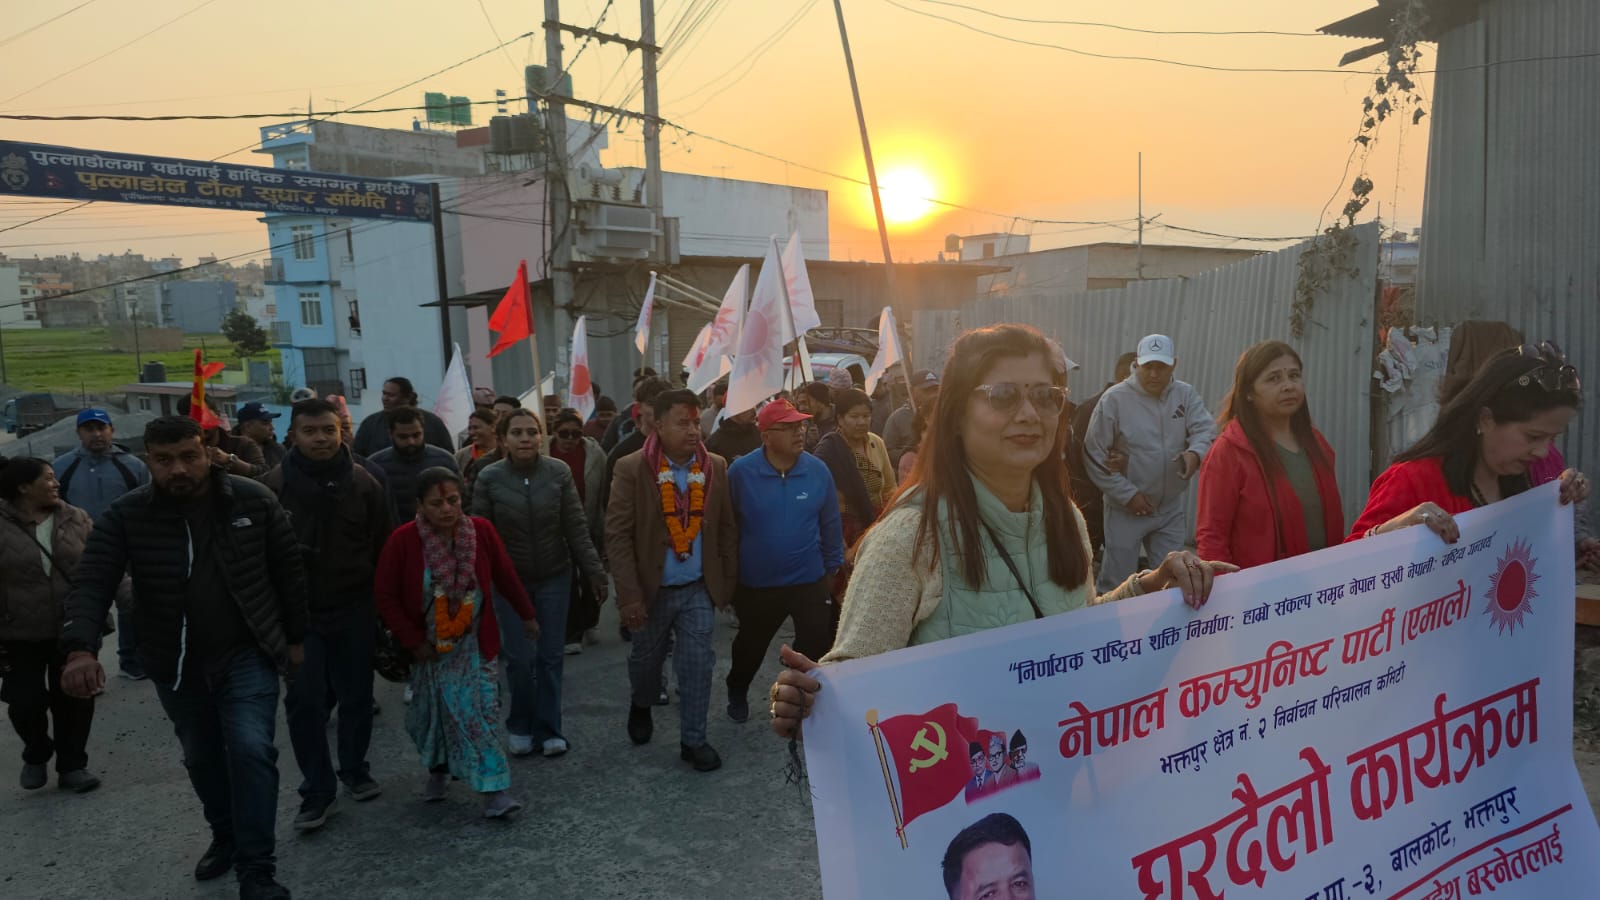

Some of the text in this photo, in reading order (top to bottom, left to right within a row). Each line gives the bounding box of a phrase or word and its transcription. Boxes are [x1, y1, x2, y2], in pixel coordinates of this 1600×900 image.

[252, 186, 316, 204] सुधार
[325, 190, 387, 209] समिति
[291, 175, 360, 190] स्वागत
[1091, 638, 1143, 663] राष्ट्रिय
[1149, 627, 1182, 651] शक्ति
[1242, 602, 1271, 625] हाम्रो
[1274, 593, 1312, 617] संकल्प
[1349, 578, 1376, 595] नेपाल
[1381, 565, 1404, 589] सुखी
[1058, 579, 1471, 758] नेपाल कम्युनिष्ट पार्टी (एमाले)
[1160, 740, 1207, 774] भक्तपुर
[1213, 728, 1234, 755] क्षेत्र
[1258, 718, 1266, 738] २
[1274, 699, 1317, 729] निर्वाचन
[1322, 679, 1373, 710] परिचालन
[1377, 660, 1406, 691] कमिटी
[1131, 677, 1540, 900] घरदैलो कार्यक्रम
[1390, 820, 1456, 872] बालकोट,
[1464, 786, 1520, 829] भक्तपुर
[1466, 823, 1563, 895] बस्नेतलाई
